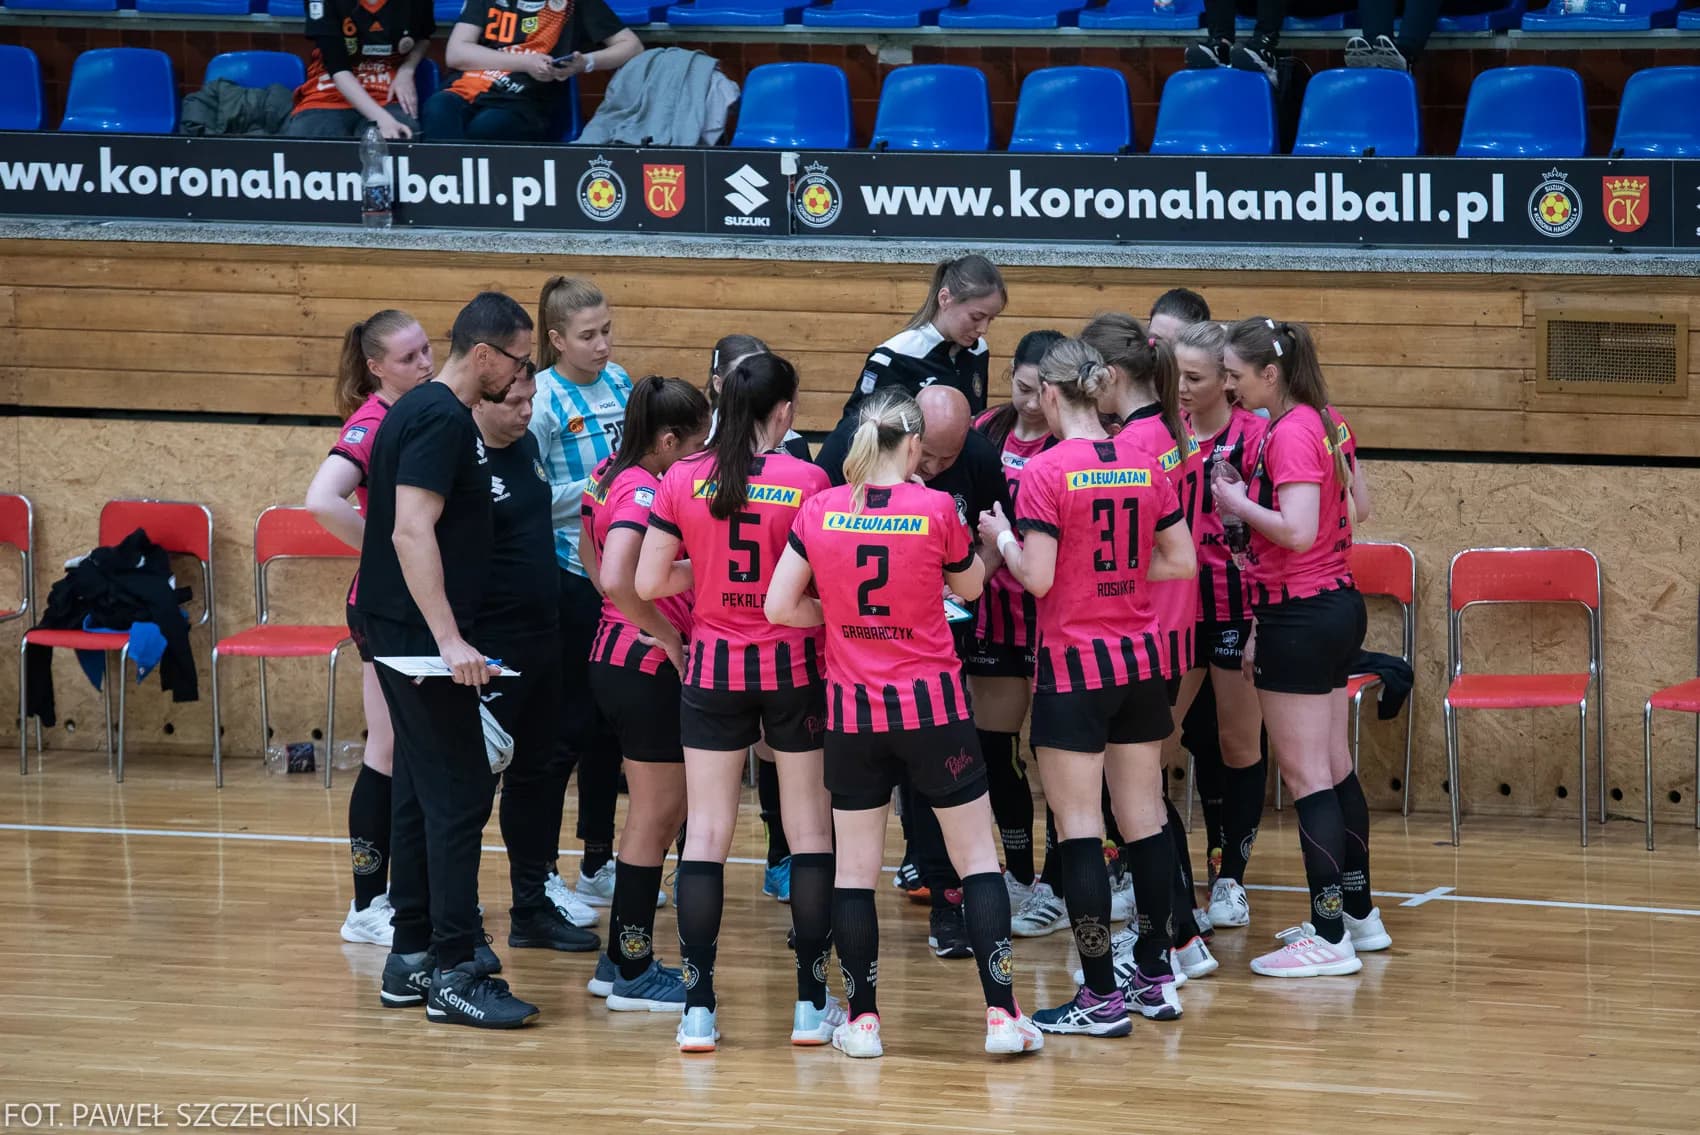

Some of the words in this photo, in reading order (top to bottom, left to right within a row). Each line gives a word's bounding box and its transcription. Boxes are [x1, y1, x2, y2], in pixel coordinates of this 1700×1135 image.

[485, 7, 518, 43] 20
[648, 185, 677, 211] CK
[860, 169, 1504, 238] www.koronahandball.pl
[1608, 198, 1641, 225] CK
[724, 216, 770, 227] SUZUKI
[1091, 470, 1147, 485] LEWIATAN
[846, 516, 922, 532] LEWIATAN
[1093, 498, 1139, 571] 31
[728, 512, 761, 582] 5
[856, 544, 890, 616] 2
[841, 624, 914, 641] GRABARCZYK
